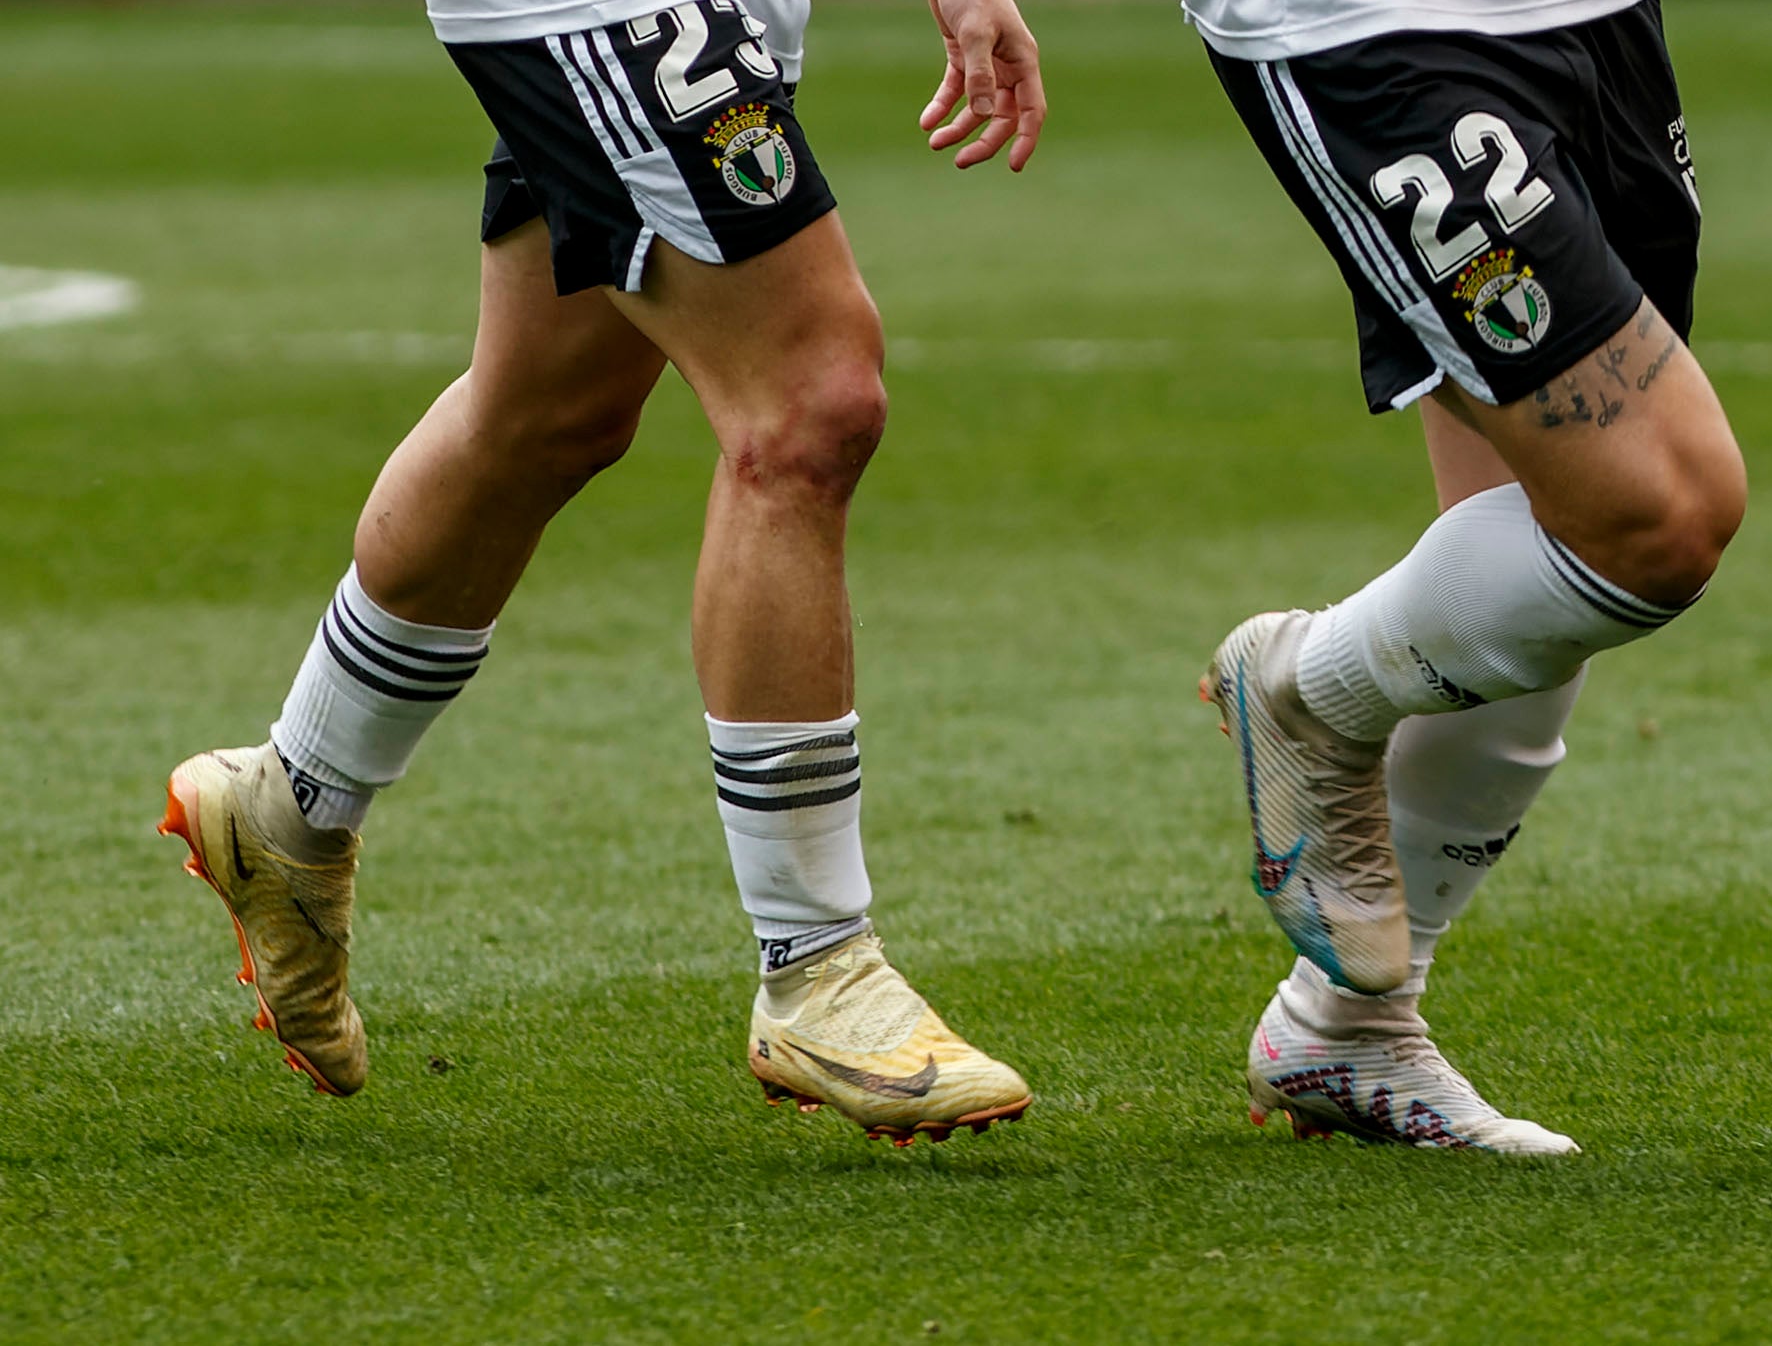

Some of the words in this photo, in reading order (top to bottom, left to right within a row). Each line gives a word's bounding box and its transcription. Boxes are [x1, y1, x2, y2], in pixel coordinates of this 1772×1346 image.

[733, 129, 759, 148] CLUB
[778, 140, 793, 180] FUTBOL
[725, 166, 758, 202] BURGOS
[1370, 110, 1556, 284] 22
